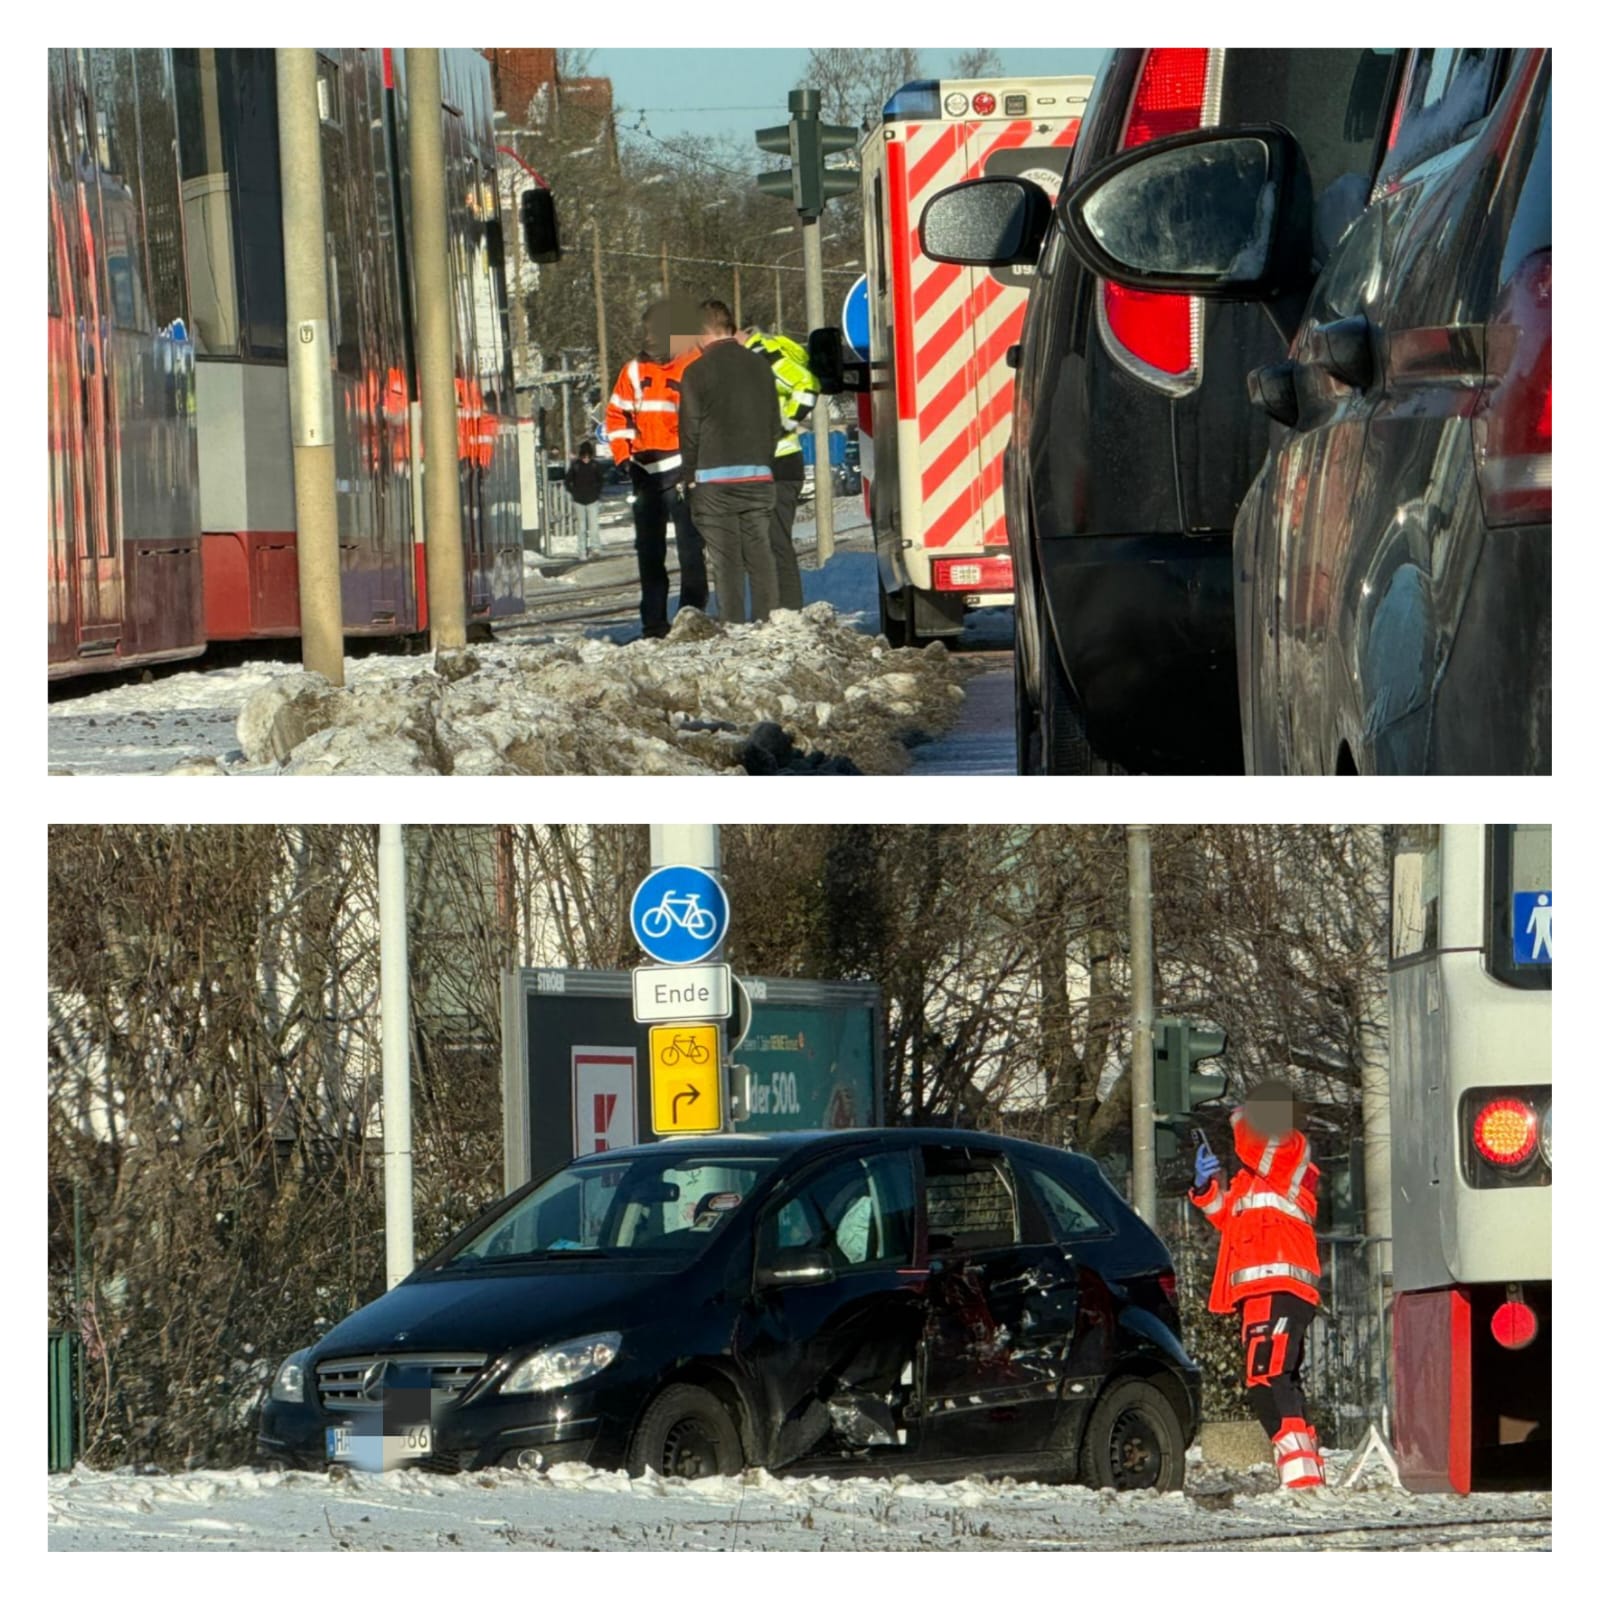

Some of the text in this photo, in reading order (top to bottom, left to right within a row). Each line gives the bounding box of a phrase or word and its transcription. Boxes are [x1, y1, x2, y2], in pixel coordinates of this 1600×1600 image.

[655, 982, 710, 1004] Ende
[772, 1071, 800, 1114] 500.
[399, 1426, 428, 1449] 66
